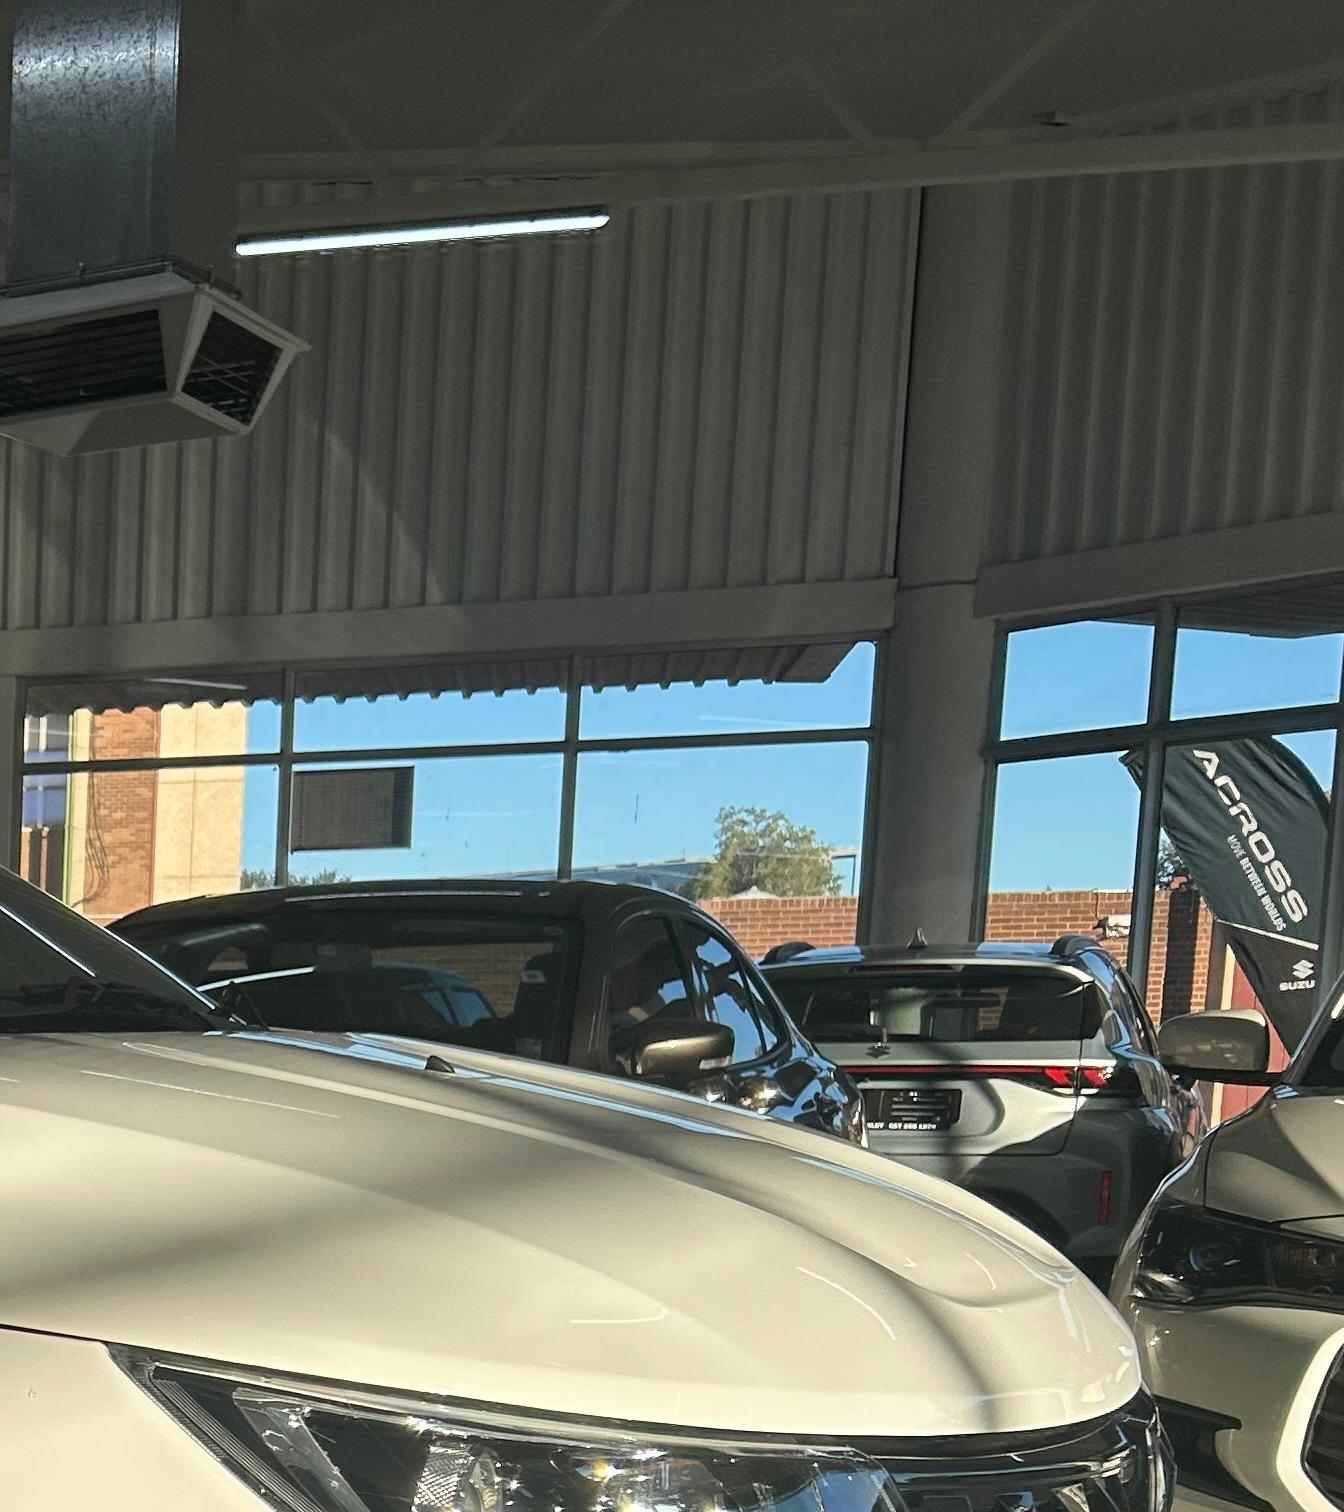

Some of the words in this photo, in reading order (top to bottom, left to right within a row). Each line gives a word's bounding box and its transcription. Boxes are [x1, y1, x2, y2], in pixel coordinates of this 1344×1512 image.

[1193, 749, 1308, 924] ACROSS
[1239, 857, 1268, 897] BETWEEN
[1279, 979, 1315, 992] SUZU
